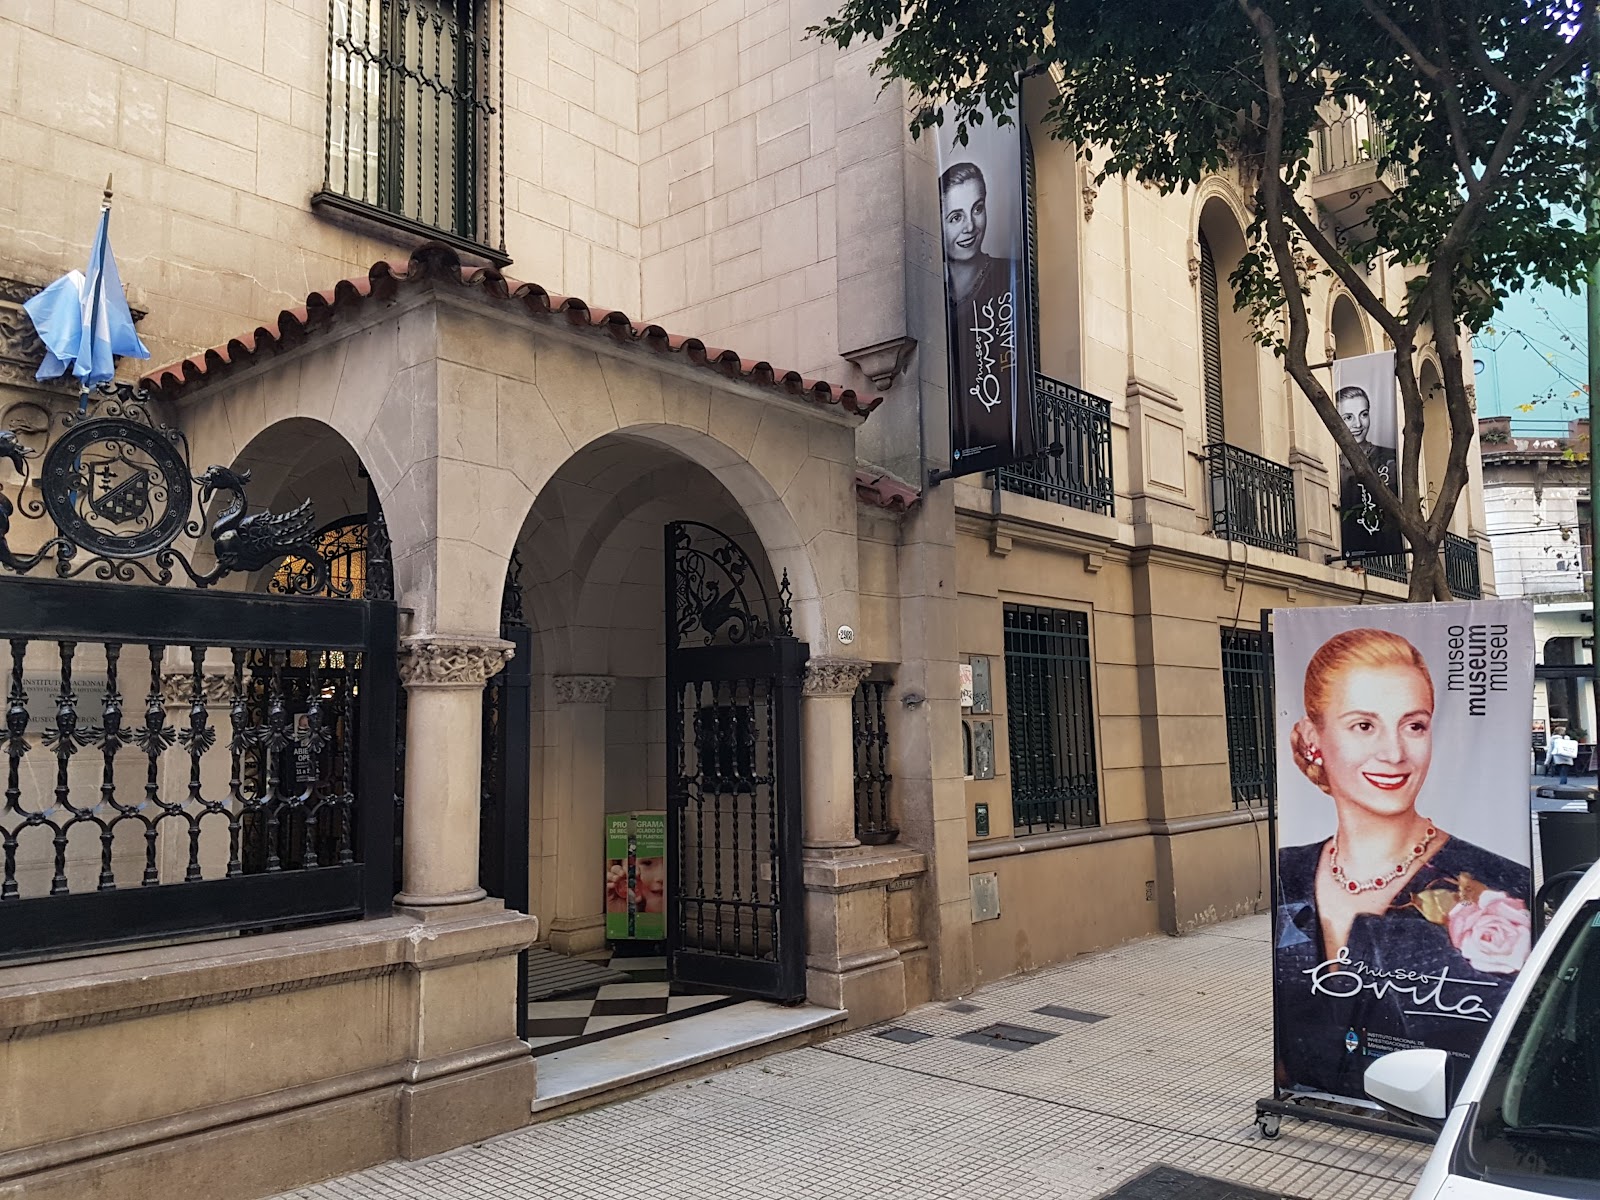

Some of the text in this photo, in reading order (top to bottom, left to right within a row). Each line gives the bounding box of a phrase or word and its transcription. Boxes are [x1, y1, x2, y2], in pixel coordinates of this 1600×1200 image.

[970, 298, 1001, 412] Evita
[996, 291, 1016, 373] 15 AÑOS
[1447, 625, 1465, 691] museo
[1468, 624, 1487, 716] museum
[1490, 624, 1508, 691] museu
[1302, 946, 1498, 1019] Evita
[1353, 960, 1428, 984] museo
[1393, 1036, 1417, 1045] NACIONAL
